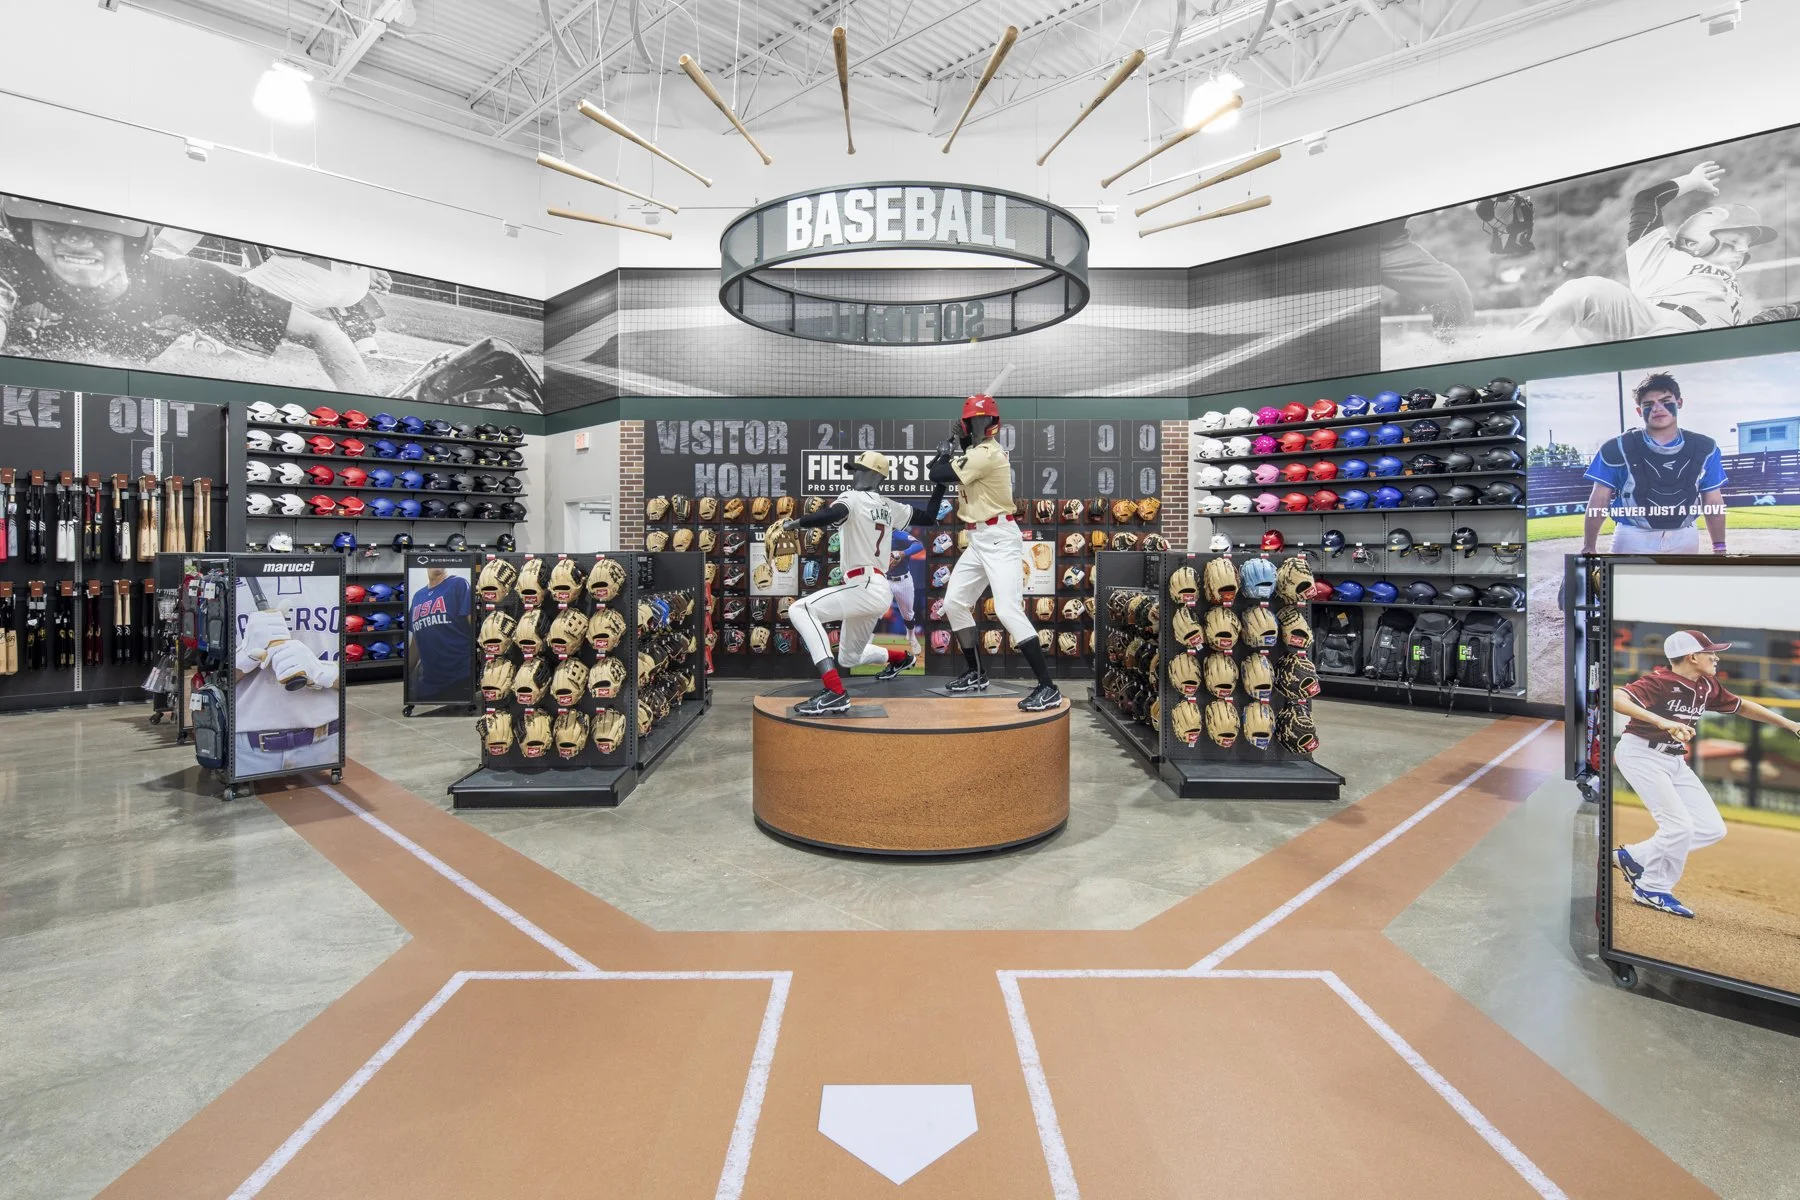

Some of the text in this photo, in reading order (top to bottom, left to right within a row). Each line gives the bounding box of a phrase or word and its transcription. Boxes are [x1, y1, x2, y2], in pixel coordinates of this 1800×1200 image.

[787, 187, 1015, 251] BASEBALL
[109, 396, 195, 437] OUT
[656, 420, 788, 455] VISITOR
[818, 423, 833, 449] 2
[858, 424, 874, 449] 0
[902, 424, 914, 449] 1
[1043, 425, 1055, 450] 1
[1139, 424, 1156, 452] 0
[694, 463, 787, 497] HOME
[1042, 467, 1057, 494] 2
[1098, 466, 1114, 494] 0
[1139, 466, 1156, 494] 0
[808, 455, 918, 481] FIELR'S
[808, 484, 826, 492] PRO
[829, 484, 856, 492] STOC
[899, 484, 916, 492] FOR
[1588, 506, 1608, 518] IT'S
[1611, 506, 1646, 517] NEVER
[1648, 505, 1676, 516] JUST
[1678, 505, 1687, 516] A
[874, 524, 885, 557] 7
[263, 561, 315, 573] marucci
[412, 596, 447, 622] USA
